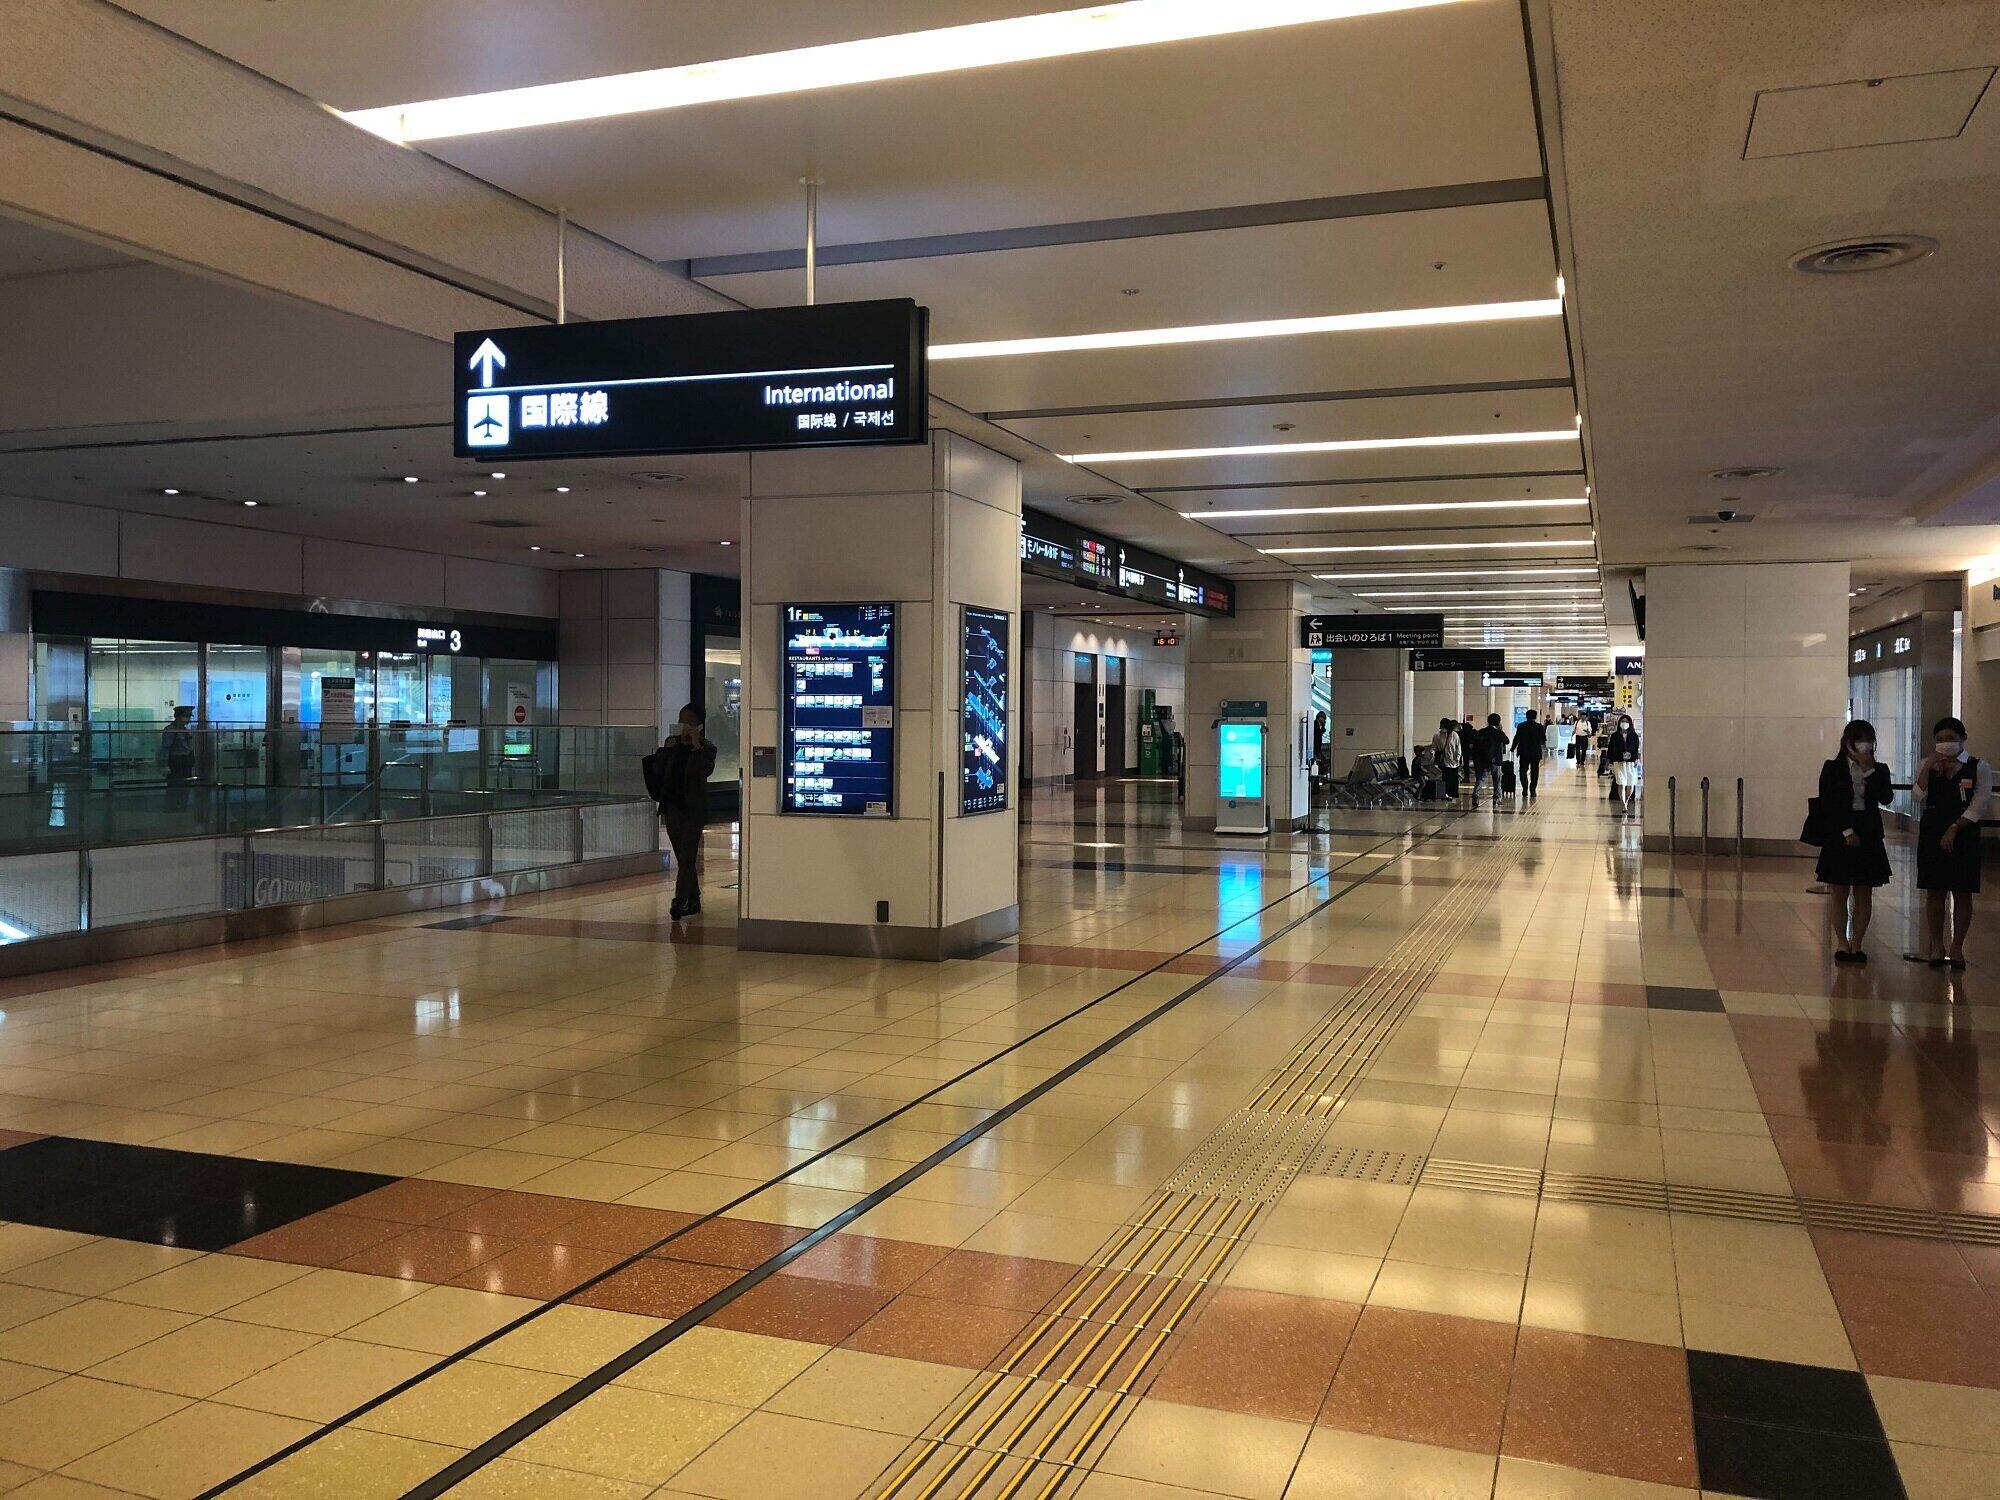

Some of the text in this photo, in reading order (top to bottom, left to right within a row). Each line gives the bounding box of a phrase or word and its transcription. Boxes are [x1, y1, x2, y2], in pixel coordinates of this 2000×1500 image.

[765, 377, 894, 406] International
[520, 390, 609, 428] 国際線
[853, 408, 895, 428] 국제선
[797, 412, 837, 430] 国际线
[788, 607, 803, 620] 1F
[450, 630, 462, 652] 3
[1397, 632, 1422, 640] Meeting
[255, 877, 282, 904] GO
